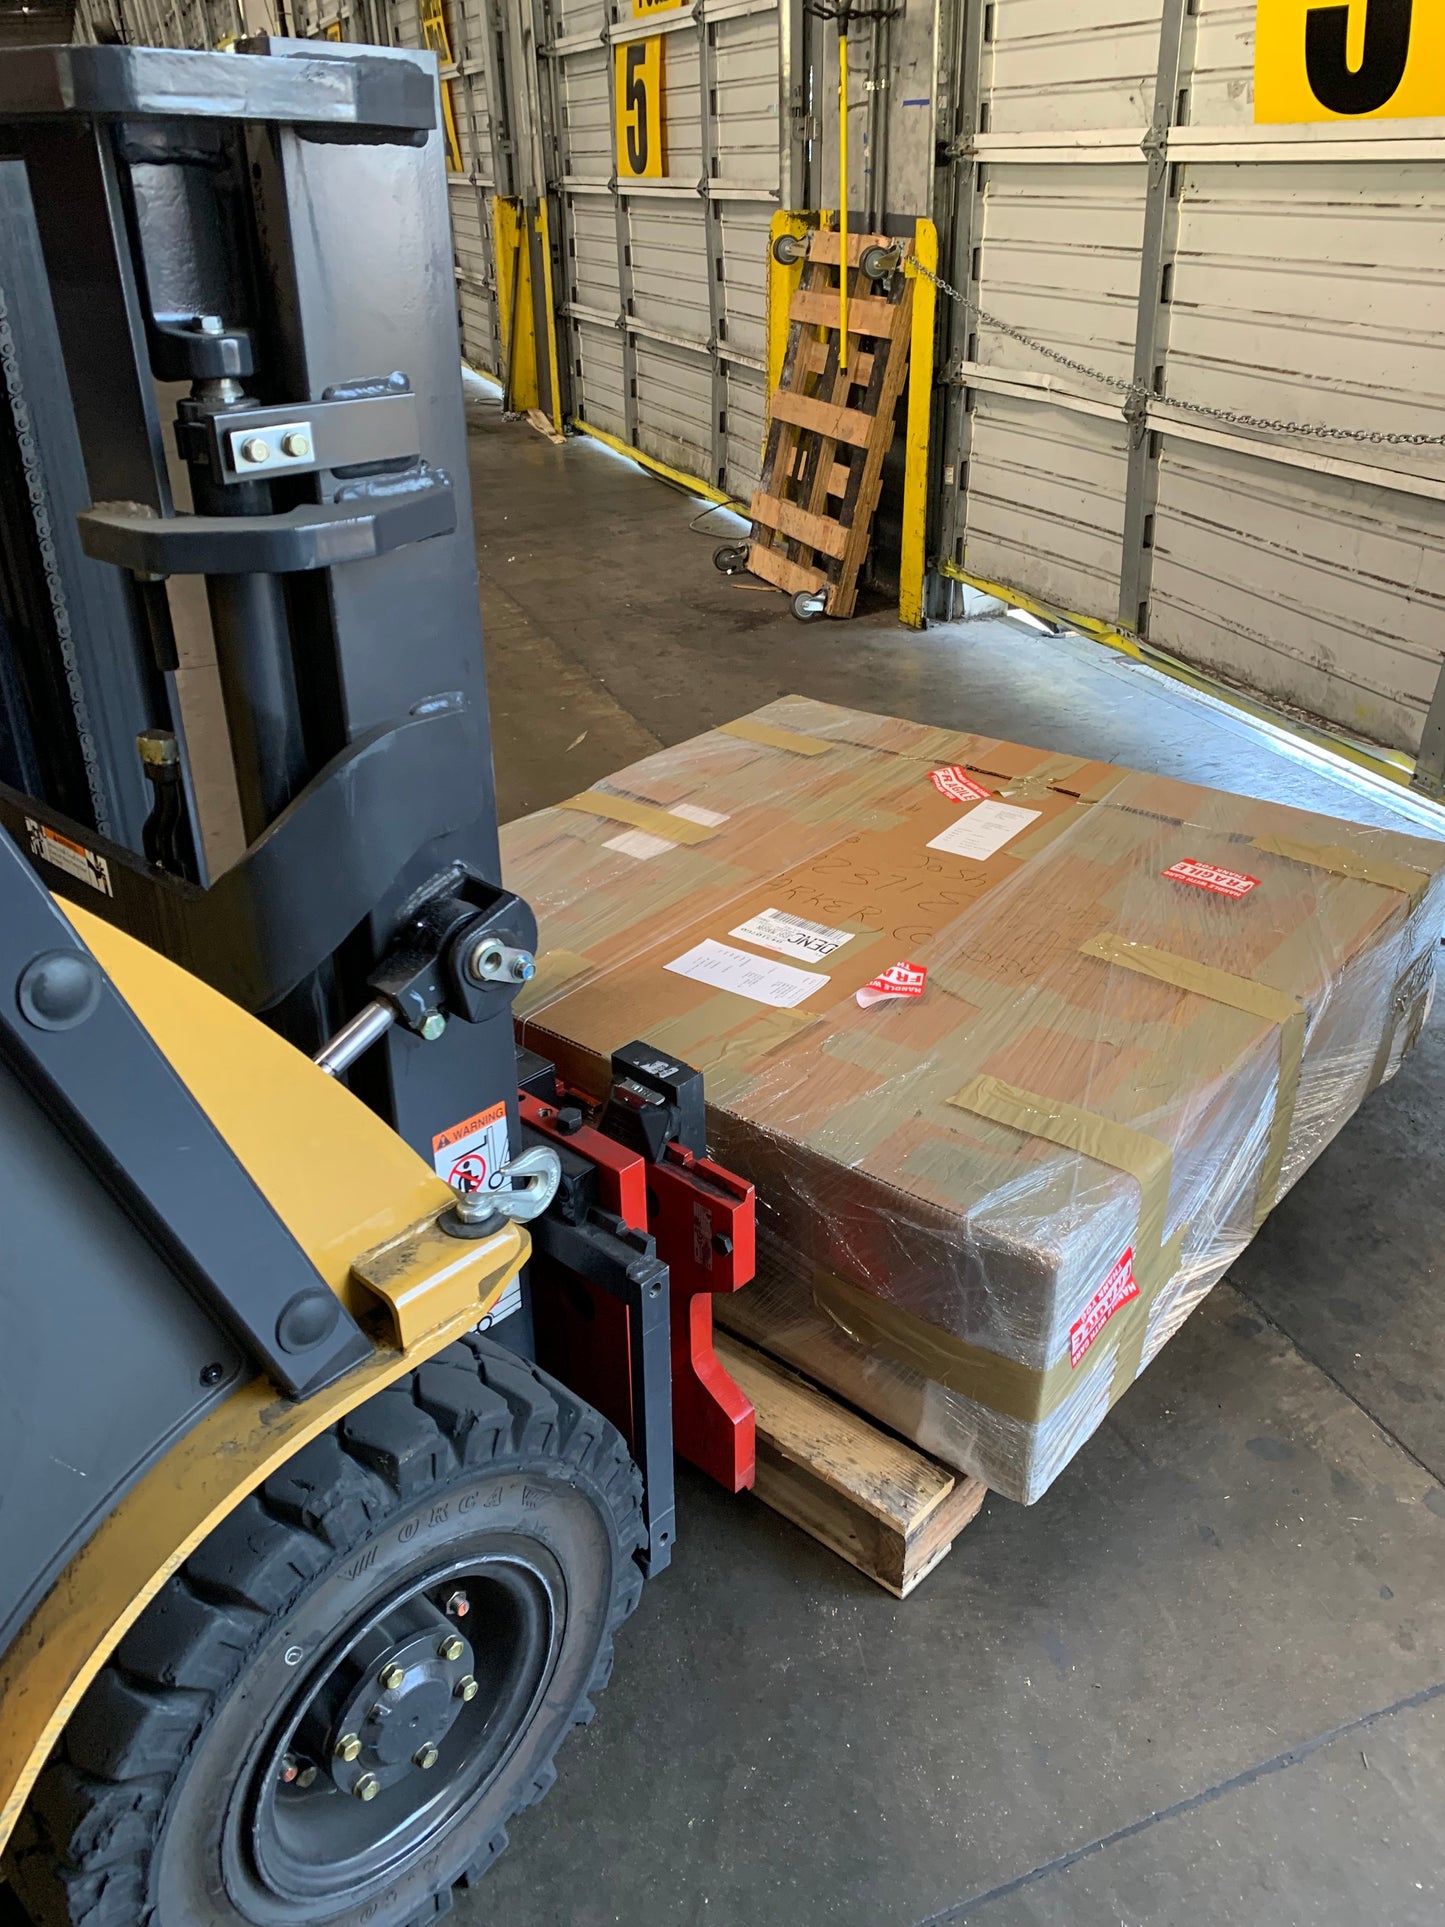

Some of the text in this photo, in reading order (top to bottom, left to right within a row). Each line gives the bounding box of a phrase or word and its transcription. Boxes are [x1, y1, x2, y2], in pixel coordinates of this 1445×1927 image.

[626, 44, 648, 175] 5
[941, 769, 977, 800] FRAGILE
[1163, 870, 1241, 897] HANDLE WITH CARE
[1174, 863, 1251, 890] FRAGILE
[1195, 862, 1248, 881] THANK YOU
[787, 932, 838, 955] DENC
[883, 983, 921, 994] HANDLE
[452, 1107, 504, 1141] WARNING
[1081, 1263, 1123, 1323] THANK YOU
[1090, 1315, 1108, 1341] WITH
[1072, 1338, 1090, 1366] CARE
